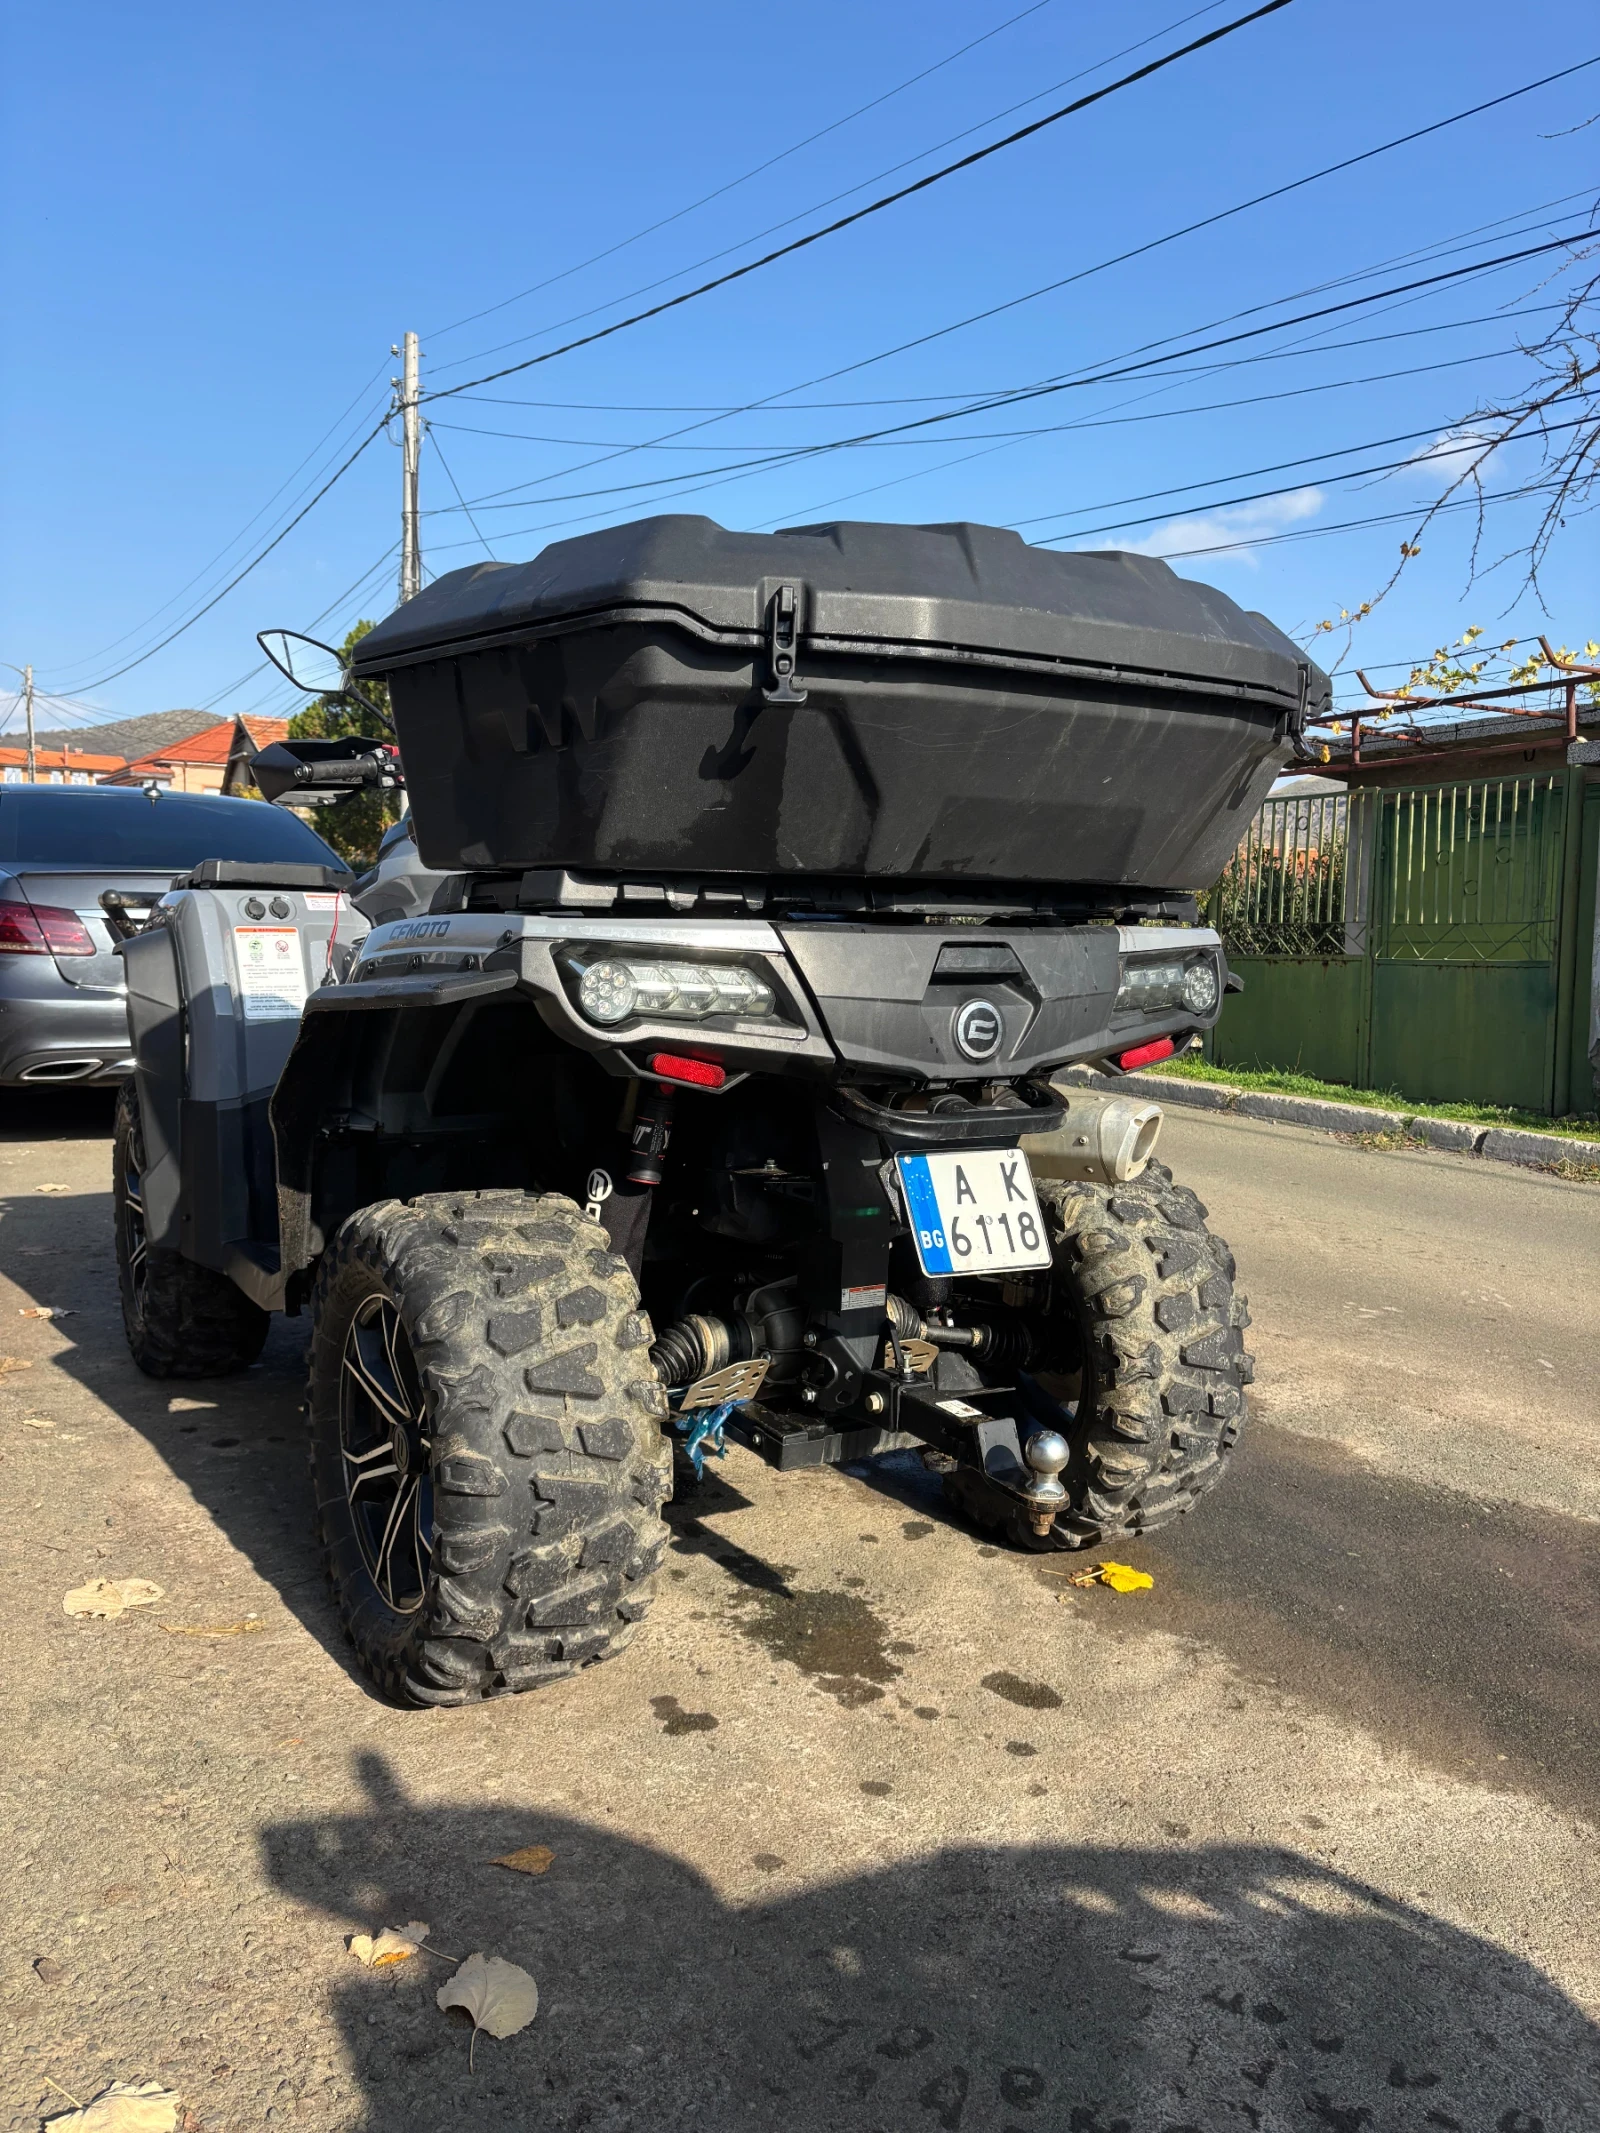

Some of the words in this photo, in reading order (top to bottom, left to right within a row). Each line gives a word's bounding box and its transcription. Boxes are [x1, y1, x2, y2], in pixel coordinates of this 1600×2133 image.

[388, 920, 451, 941] CFMOTO
[955, 1164, 978, 1205] A
[1000, 1161, 1029, 1202] K
[920, 1229, 945, 1249] BG
[951, 1211, 1040, 1257] 6118
